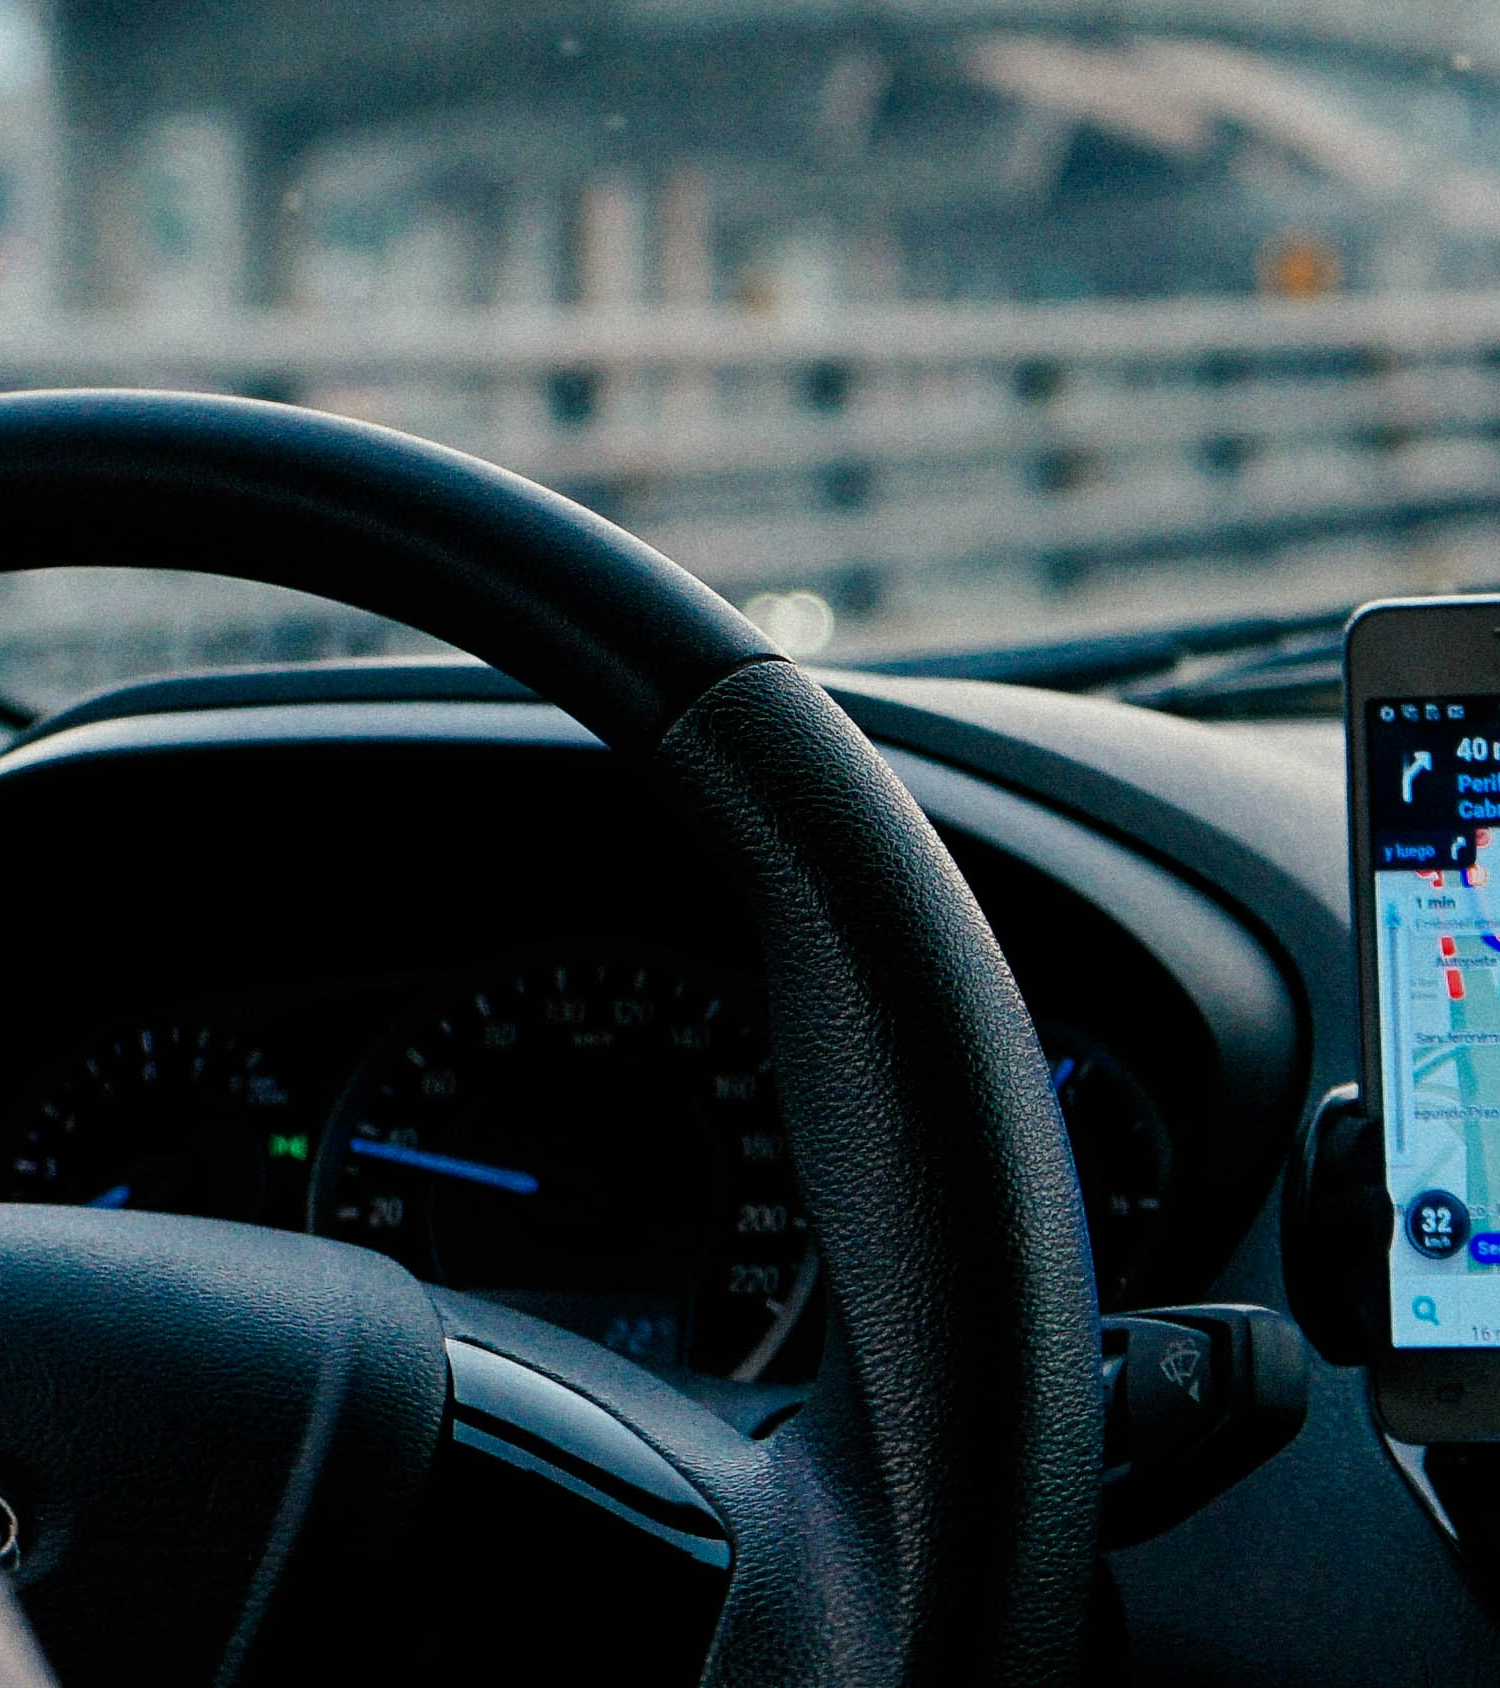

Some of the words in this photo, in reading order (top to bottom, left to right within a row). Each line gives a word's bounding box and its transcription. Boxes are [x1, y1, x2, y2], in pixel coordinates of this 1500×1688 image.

[1456, 737, 1489, 762] 40
[1384, 848, 1394, 863] y
[1396, 843, 1436, 863] luego
[1428, 896, 1456, 909] min
[368, 1196, 403, 1229] 20
[736, 1205, 787, 1233] 200
[1420, 1207, 1452, 1234] 32
[727, 1264, 780, 1295] 220
[1471, 1326, 1491, 1341] 16
